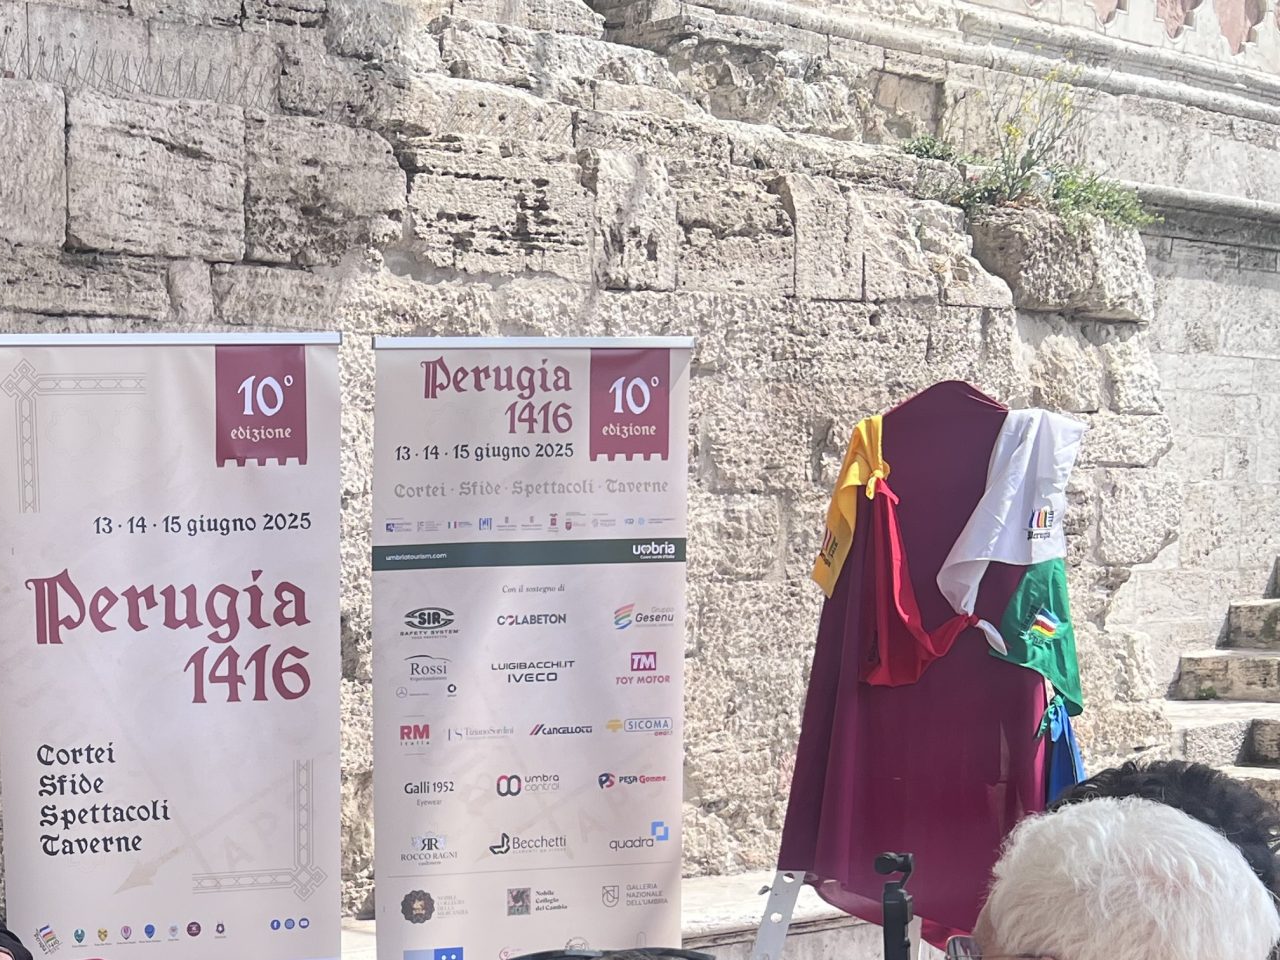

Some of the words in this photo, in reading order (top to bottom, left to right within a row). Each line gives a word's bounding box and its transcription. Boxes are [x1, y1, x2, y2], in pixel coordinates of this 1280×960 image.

[420, 356, 572, 400] Perugia
[504, 400, 573, 434] 1416
[230, 425, 291, 443] edizione
[602, 423, 656, 439] edizione
[394, 445, 411, 461] 13
[423, 444, 440, 460] 14
[452, 444, 470, 459] 15
[474, 442, 531, 462] giugno
[535, 442, 574, 457] 2025
[394, 482, 447, 498] Cortei
[458, 480, 502, 496] Sfide
[511, 479, 595, 498] Spettacoli
[605, 478, 669, 493] Taverne
[93, 516, 113, 535] 13
[126, 515, 147, 533] 14
[163, 514, 182, 533] 15
[187, 513, 257, 537] giugno
[263, 511, 312, 531] 2025
[385, 552, 447, 562] umbriatourism.com
[502, 585, 517, 594] Con
[518, 585, 524, 593] il
[526, 585, 556, 595] sostegno
[558, 584, 566, 592] di
[24, 568, 311, 645] Perugia
[417, 611, 442, 626] SIR
[635, 613, 674, 624] Gesenu
[410, 661, 447, 676] Rossi
[491, 660, 576, 671] LUIGIBACCHI.IT
[632, 654, 656, 670] TM
[183, 644, 312, 704] 1416
[507, 672, 558, 683] IVECO
[615, 676, 634, 685] TOY
[636, 675, 670, 685] MOTOR
[400, 723, 430, 740] RM
[628, 719, 669, 730] SICOMA
[36, 741, 116, 767] Cortei
[38, 773, 104, 797] Sfide
[524, 773, 560, 784] umbra
[618, 775, 638, 785] PESA
[639, 774, 666, 784] Gomme
[404, 782, 430, 795] Galli
[432, 781, 455, 793] 1952
[524, 782, 560, 792] control
[416, 798, 442, 808] Eyewear
[39, 799, 171, 830] Spettacoli
[40, 833, 142, 857] Taverne
[512, 835, 567, 850] Becchetti
[609, 836, 654, 851] quadra
[400, 852, 431, 862] ROCCO
[433, 850, 458, 860] RAGNI
[625, 883, 658, 891] GALLERIA
[625, 898, 668, 907] DELL'UMBRIA
